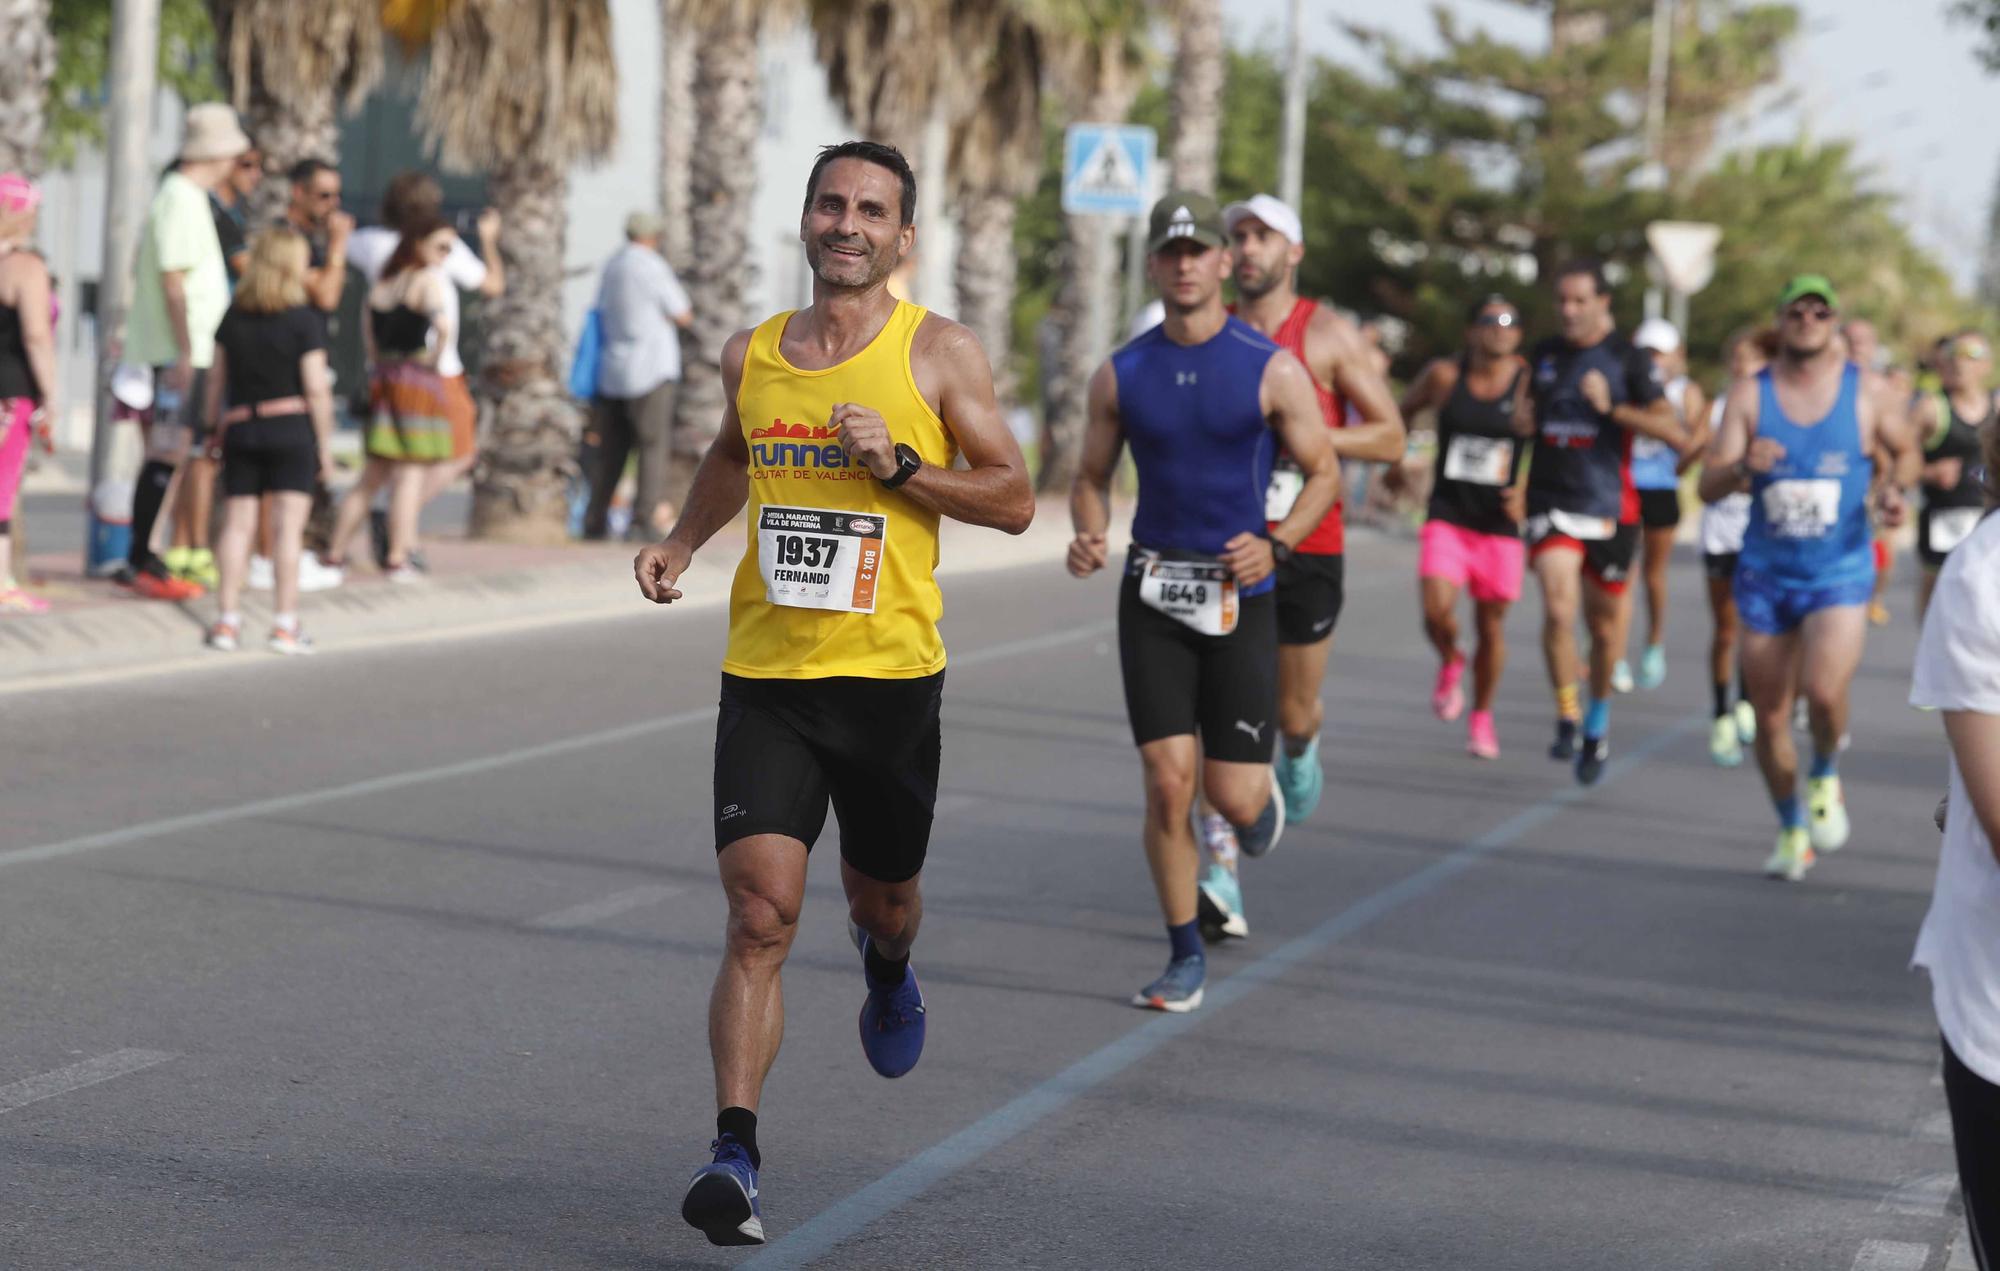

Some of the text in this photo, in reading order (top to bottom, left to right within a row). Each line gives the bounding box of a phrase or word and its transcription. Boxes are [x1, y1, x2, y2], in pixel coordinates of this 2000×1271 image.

[793, 470, 811, 479] DE
[786, 513, 820, 522] MARATÓN
[791, 520, 821, 529] PATERNA
[776, 535, 839, 568] 1937
[863, 550, 876, 570] BOX
[774, 569, 830, 585] FERNANDO
[1160, 582, 1207, 605] 1649
